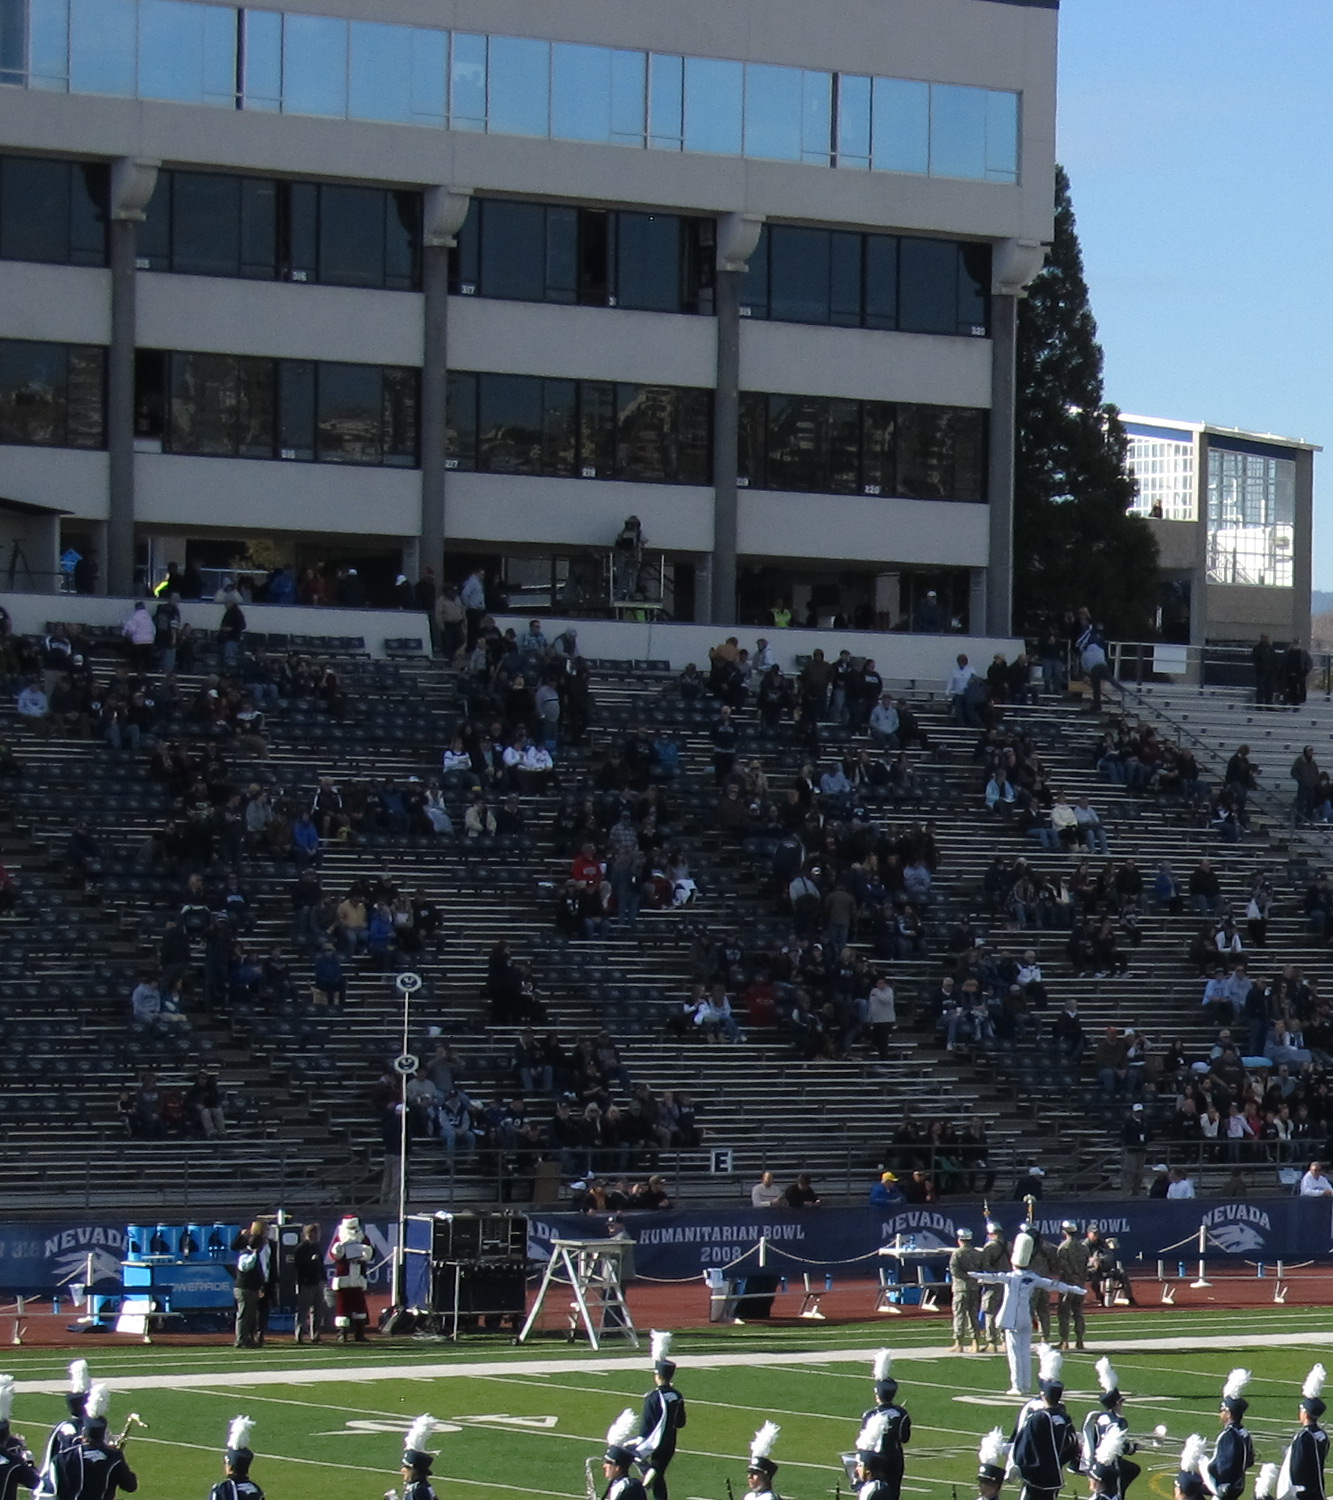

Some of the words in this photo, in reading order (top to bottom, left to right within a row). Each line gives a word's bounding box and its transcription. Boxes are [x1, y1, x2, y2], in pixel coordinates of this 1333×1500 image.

[718, 1151, 731, 1170] E
[882, 1210, 957, 1240] NEVADA
[1033, 1219, 1087, 1235] HAWI'I
[1200, 1203, 1272, 1231] NEVADA
[639, 1225, 760, 1245] HUMANITARIAN
[762, 1224, 806, 1241] BOWL
[699, 1246, 743, 1262] 2008
